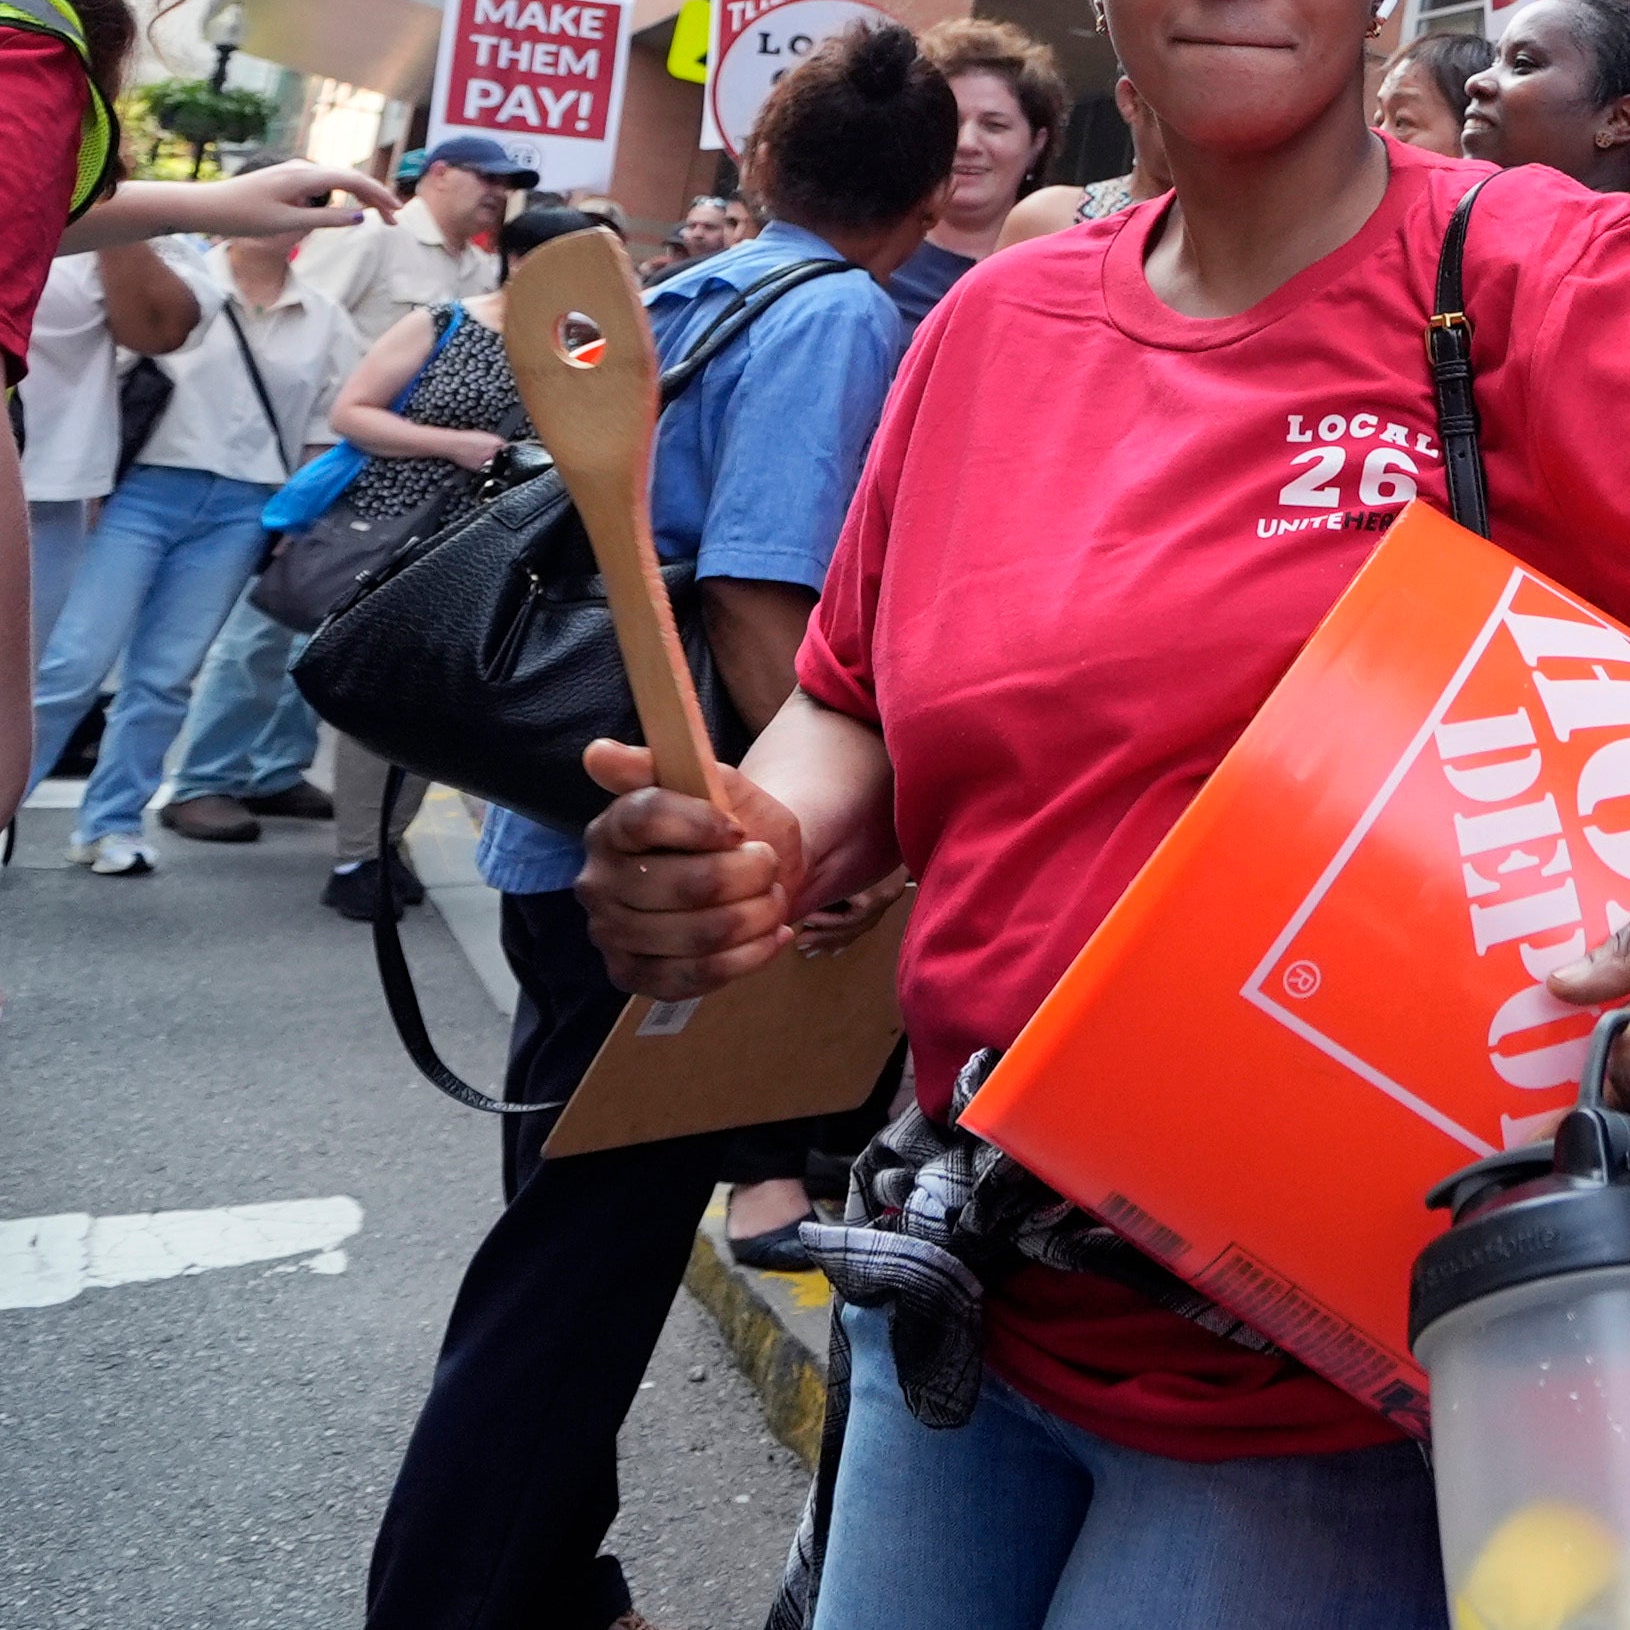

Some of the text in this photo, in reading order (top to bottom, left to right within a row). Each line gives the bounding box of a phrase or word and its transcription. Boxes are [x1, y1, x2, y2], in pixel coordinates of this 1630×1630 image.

[469, 33, 601, 80] THEM
[463, 78, 595, 133] PAY!
[1286, 412, 1440, 459] LOCAL
[1278, 445, 1420, 509] 26
[1434, 705, 1604, 1157] DEPO
